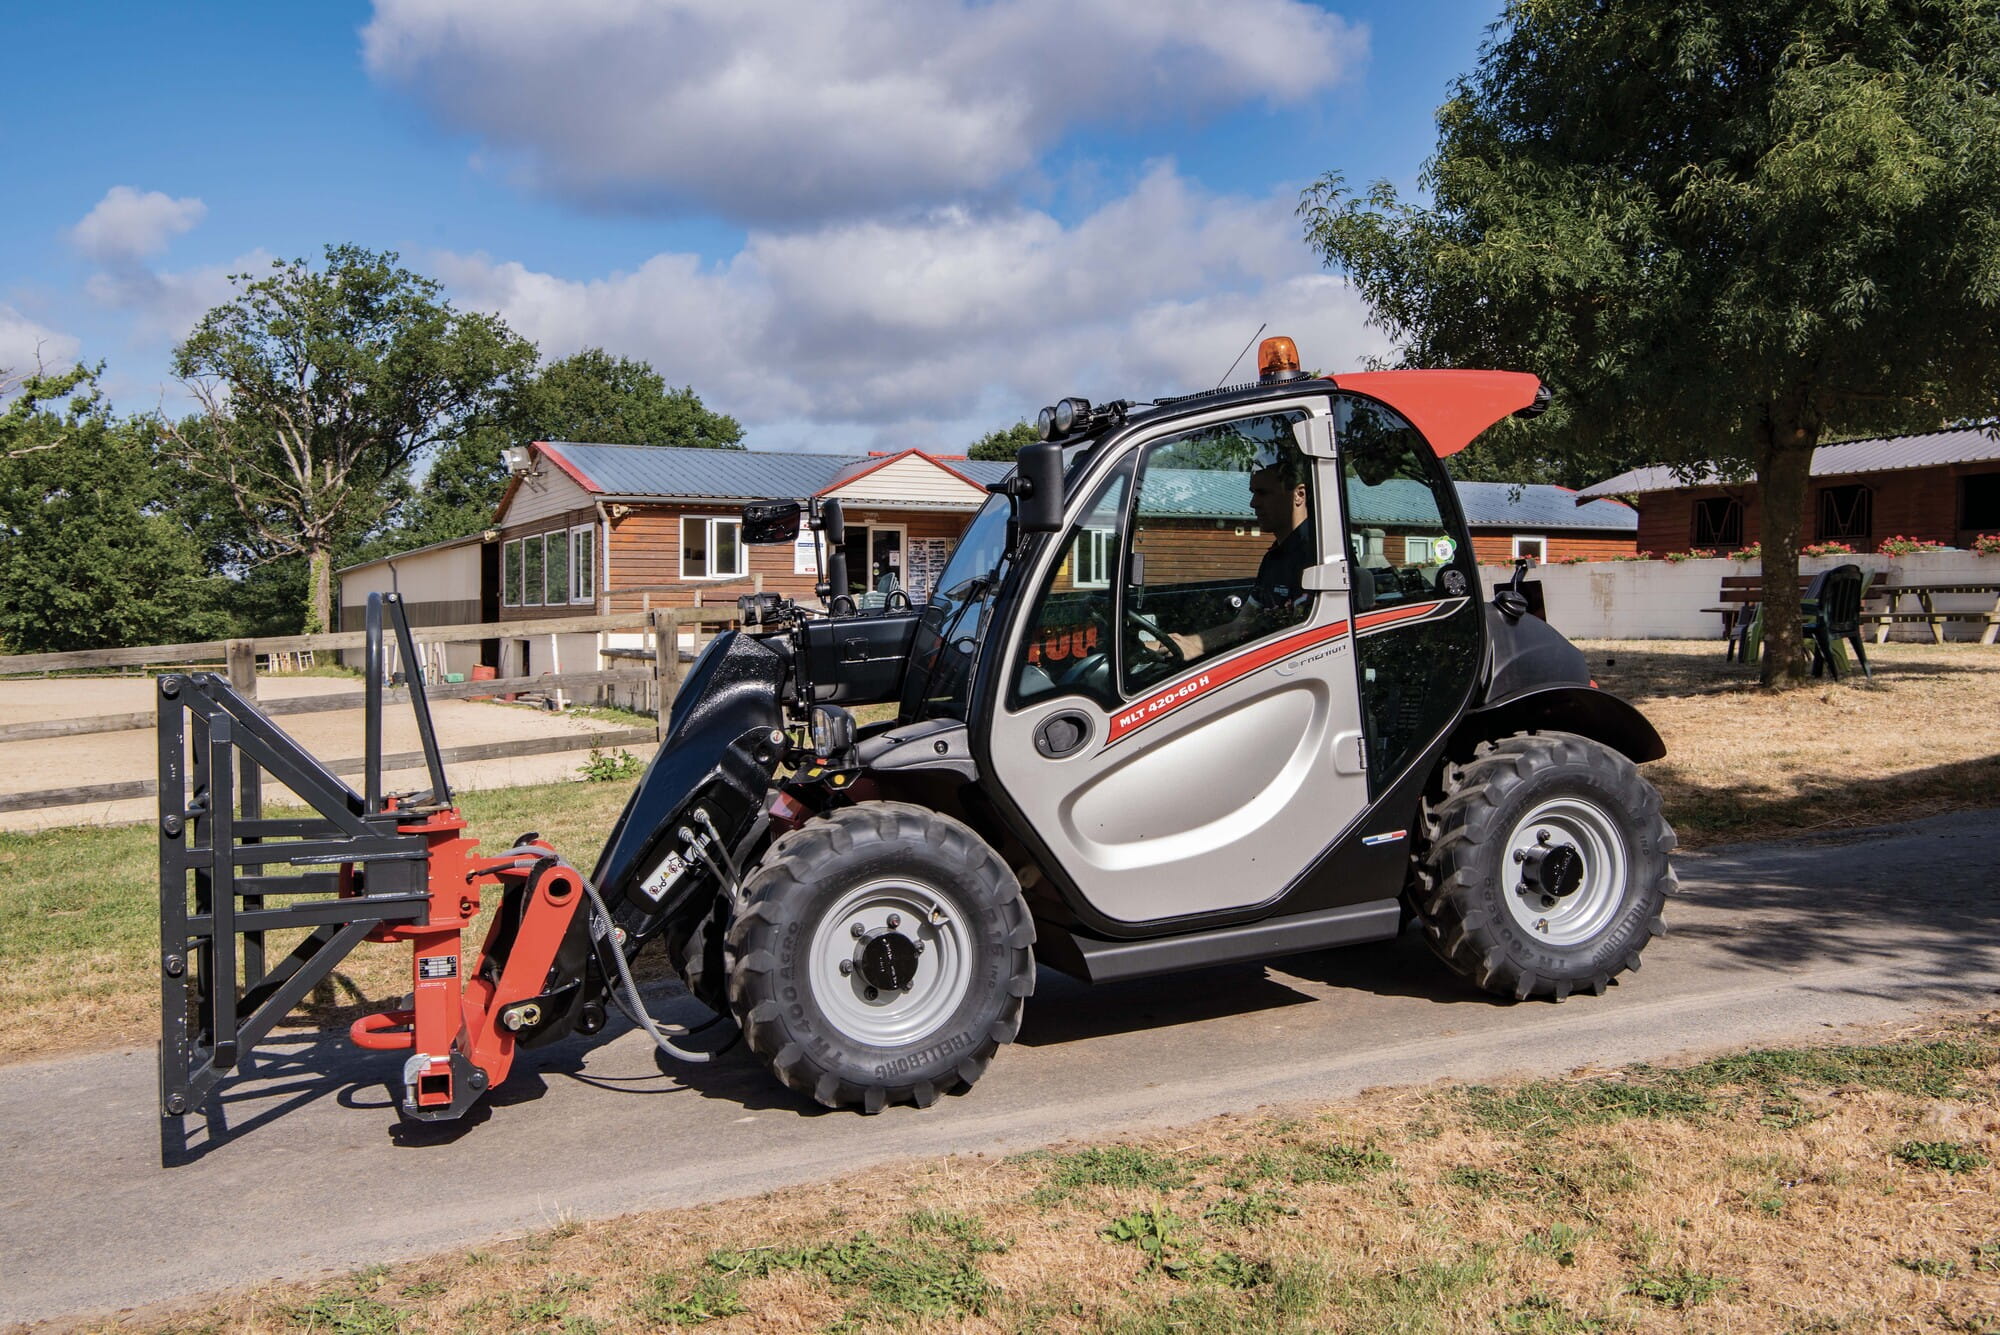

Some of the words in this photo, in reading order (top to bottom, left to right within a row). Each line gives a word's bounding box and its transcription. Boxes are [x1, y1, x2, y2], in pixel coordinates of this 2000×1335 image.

[1120, 709, 1145, 728] MLT
[1148, 682, 1197, 712] 420-60
[1200, 675, 1210, 687] H
[779, 920, 799, 980] AGRO
[782, 985, 812, 1033] 400
[874, 1031, 976, 1081] TRELLEBORG
